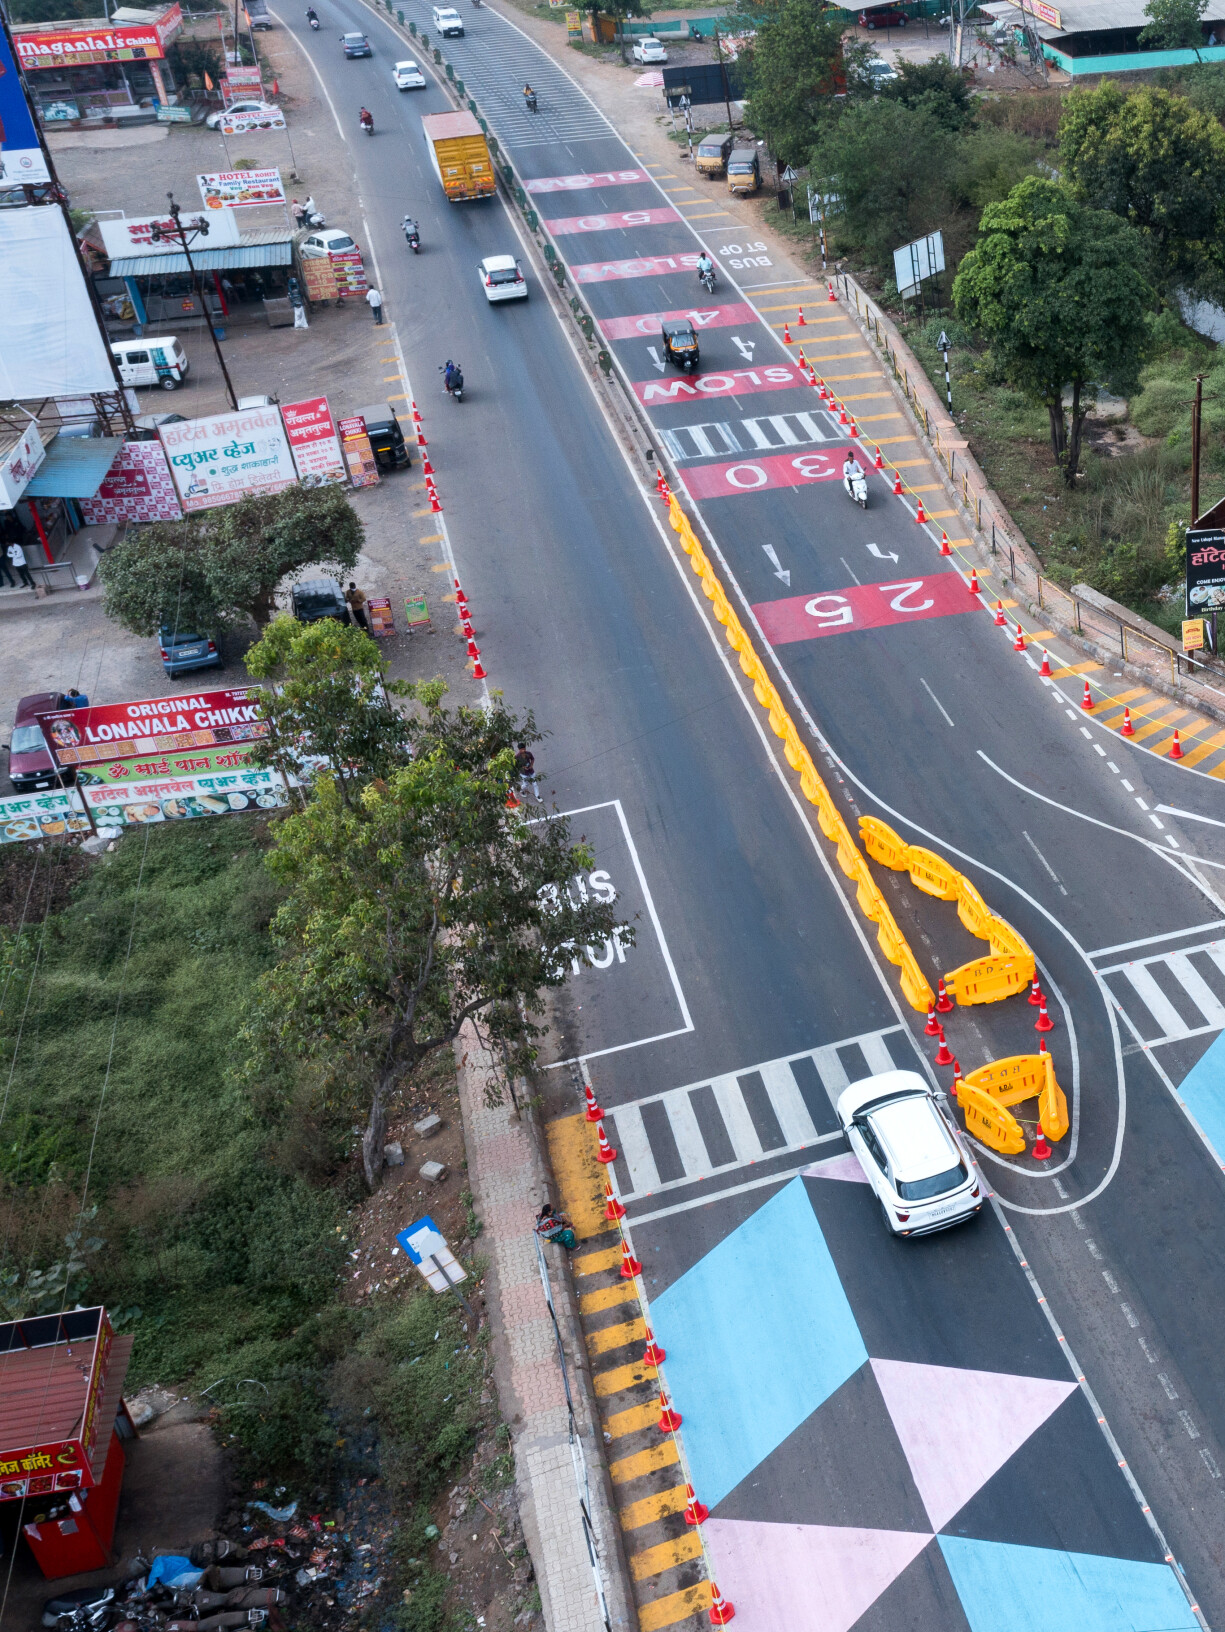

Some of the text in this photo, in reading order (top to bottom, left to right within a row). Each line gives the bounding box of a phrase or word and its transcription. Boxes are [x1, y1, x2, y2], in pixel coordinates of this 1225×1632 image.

[17, 34, 125, 56] Maganlal's
[126, 37, 157, 46] Chikki
[219, 172, 253, 181] HOTEL
[242, 177, 280, 185] Restaurant
[526, 171, 640, 191] SLOW
[577, 212, 651, 230] 50
[719, 241, 768, 256] STOP
[732, 255, 773, 269] BUS
[643, 367, 794, 400] SLOW
[162, 423, 208, 447] हॉटेल
[340, 421, 364, 431] LONAVALA
[345, 428, 362, 436] CHIKKI
[170, 440, 257, 472] प्युअर व्हेज
[725, 455, 835, 488] 30
[804, 580, 934, 628] 25
[127, 697, 212, 718] ORIGINAL
[85, 714, 191, 744] LONAVALA
[135, 757, 171, 776] साई
[175, 756, 211, 771] पान
[241, 770, 271, 786] व्हेज
[536, 869, 617, 917] BUS
[21, 1453, 54, 1474] कॉर्नर
